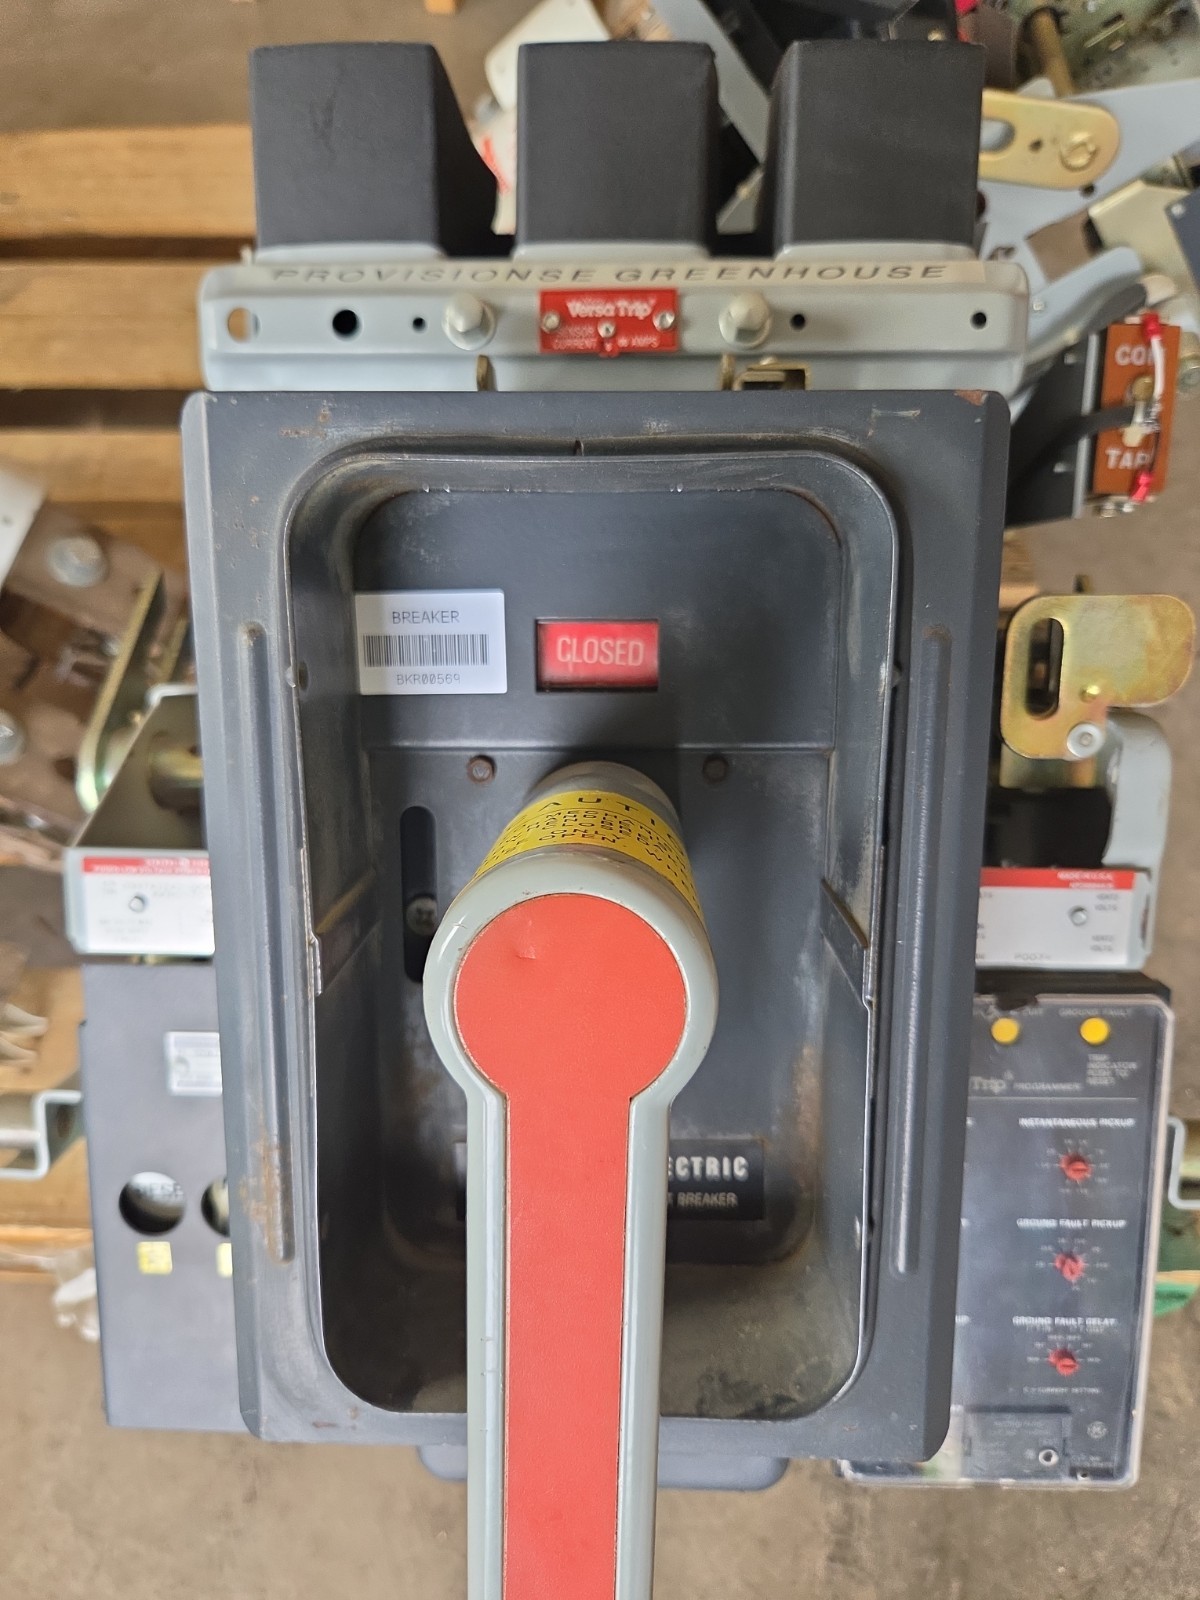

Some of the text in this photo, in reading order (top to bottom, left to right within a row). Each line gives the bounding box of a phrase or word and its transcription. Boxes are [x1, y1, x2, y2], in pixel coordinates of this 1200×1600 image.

[272, 265, 947, 283] PROVISIONSE GREENHOUSE
[392, 610, 460, 625] BREAKER
[556, 635, 645, 667] CLOSED
[396, 673, 461, 685] BKR00569
[677, 1192, 738, 1208] BREAKER
[1016, 1218, 1128, 1229] GROUND FAULT PICKUP
